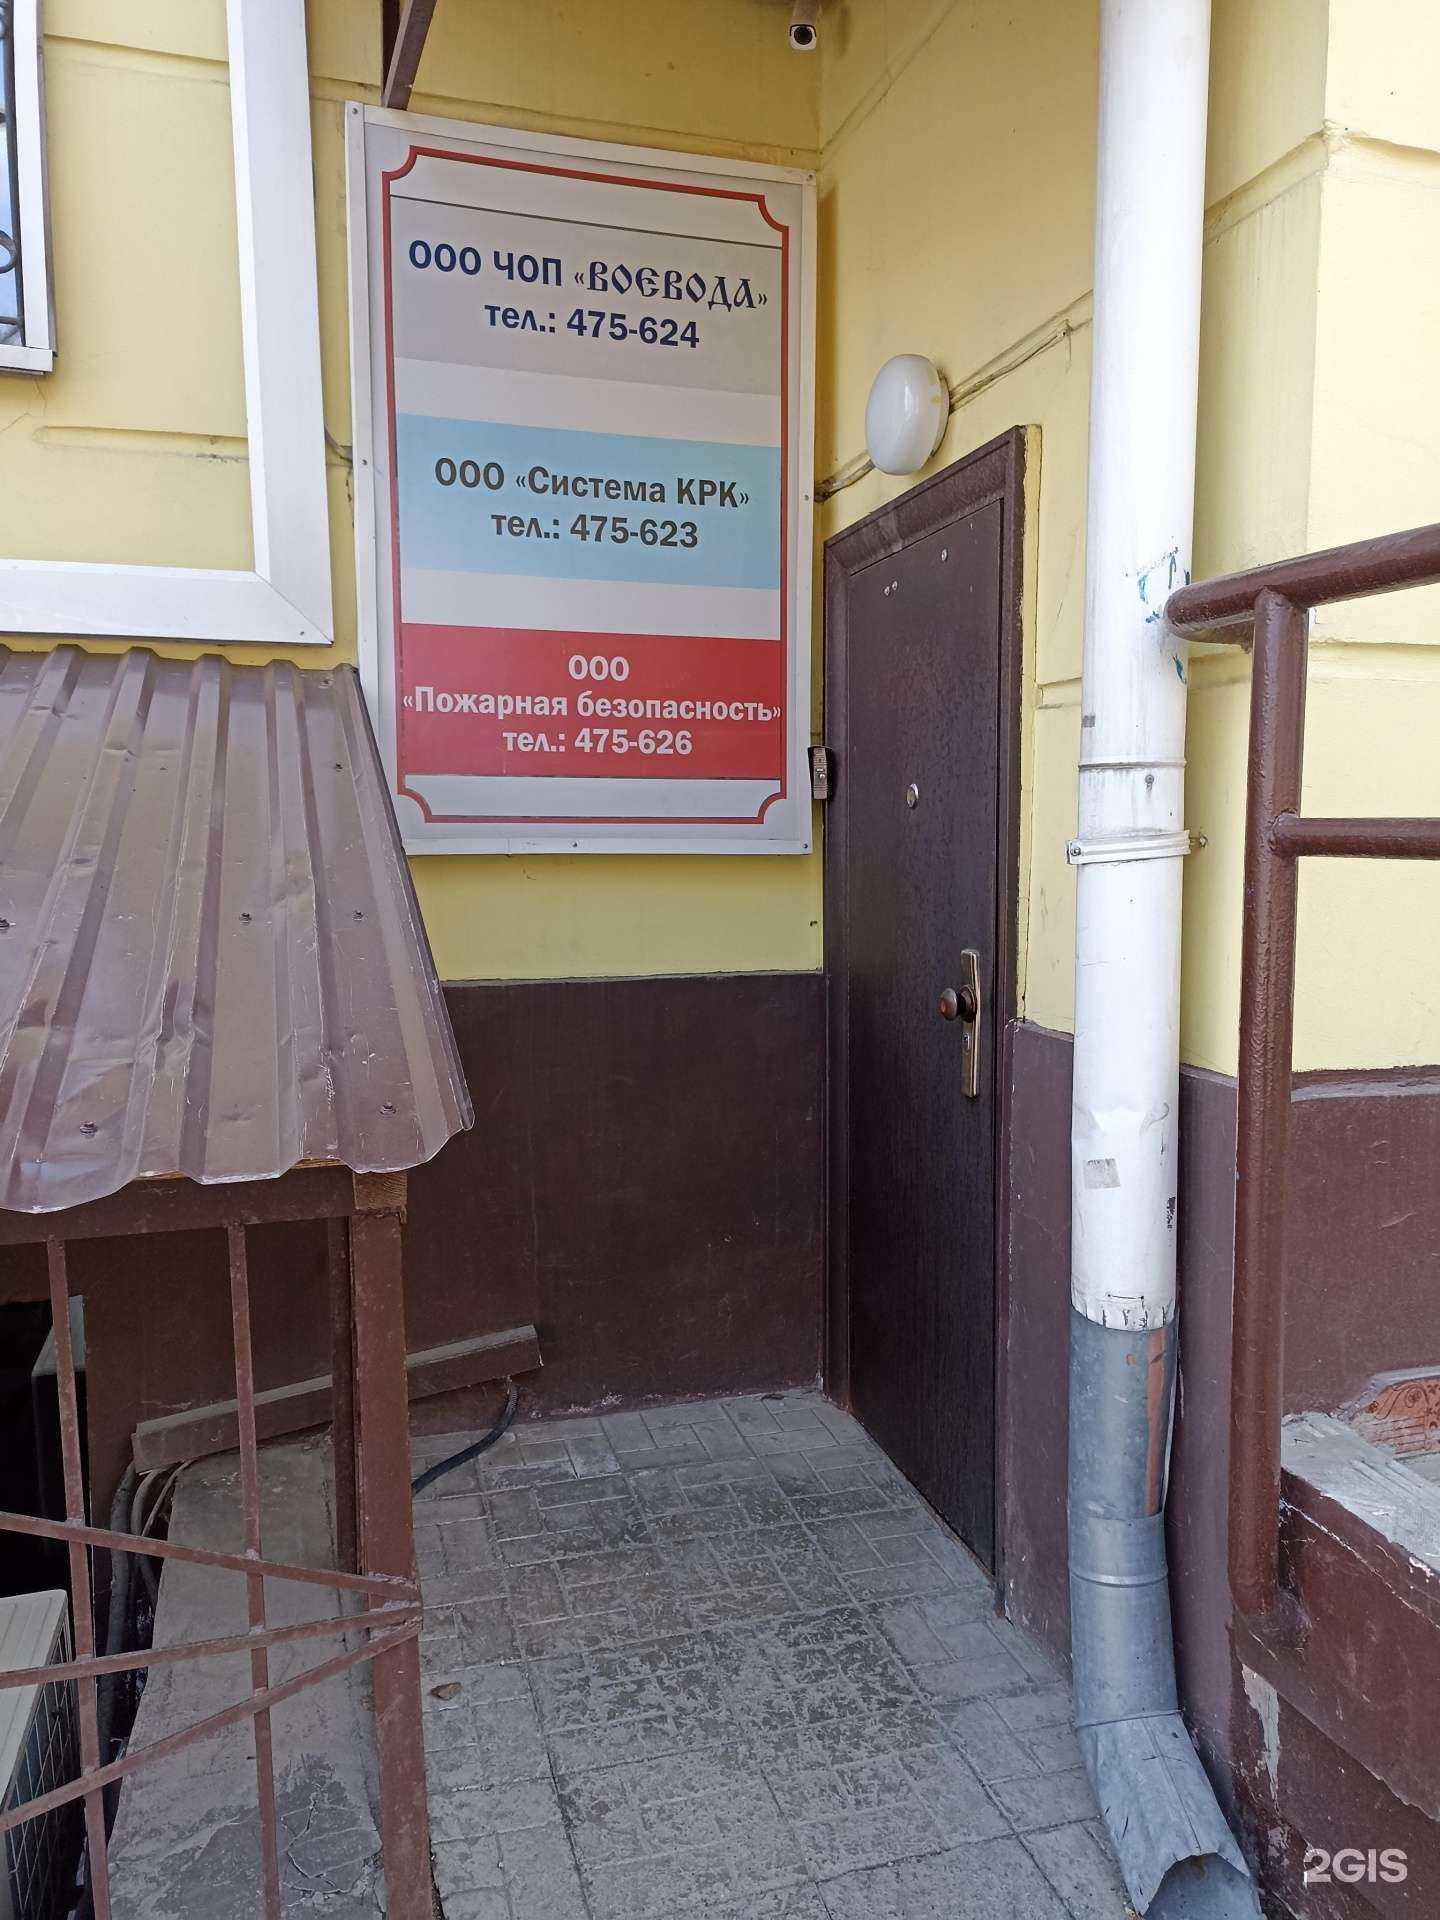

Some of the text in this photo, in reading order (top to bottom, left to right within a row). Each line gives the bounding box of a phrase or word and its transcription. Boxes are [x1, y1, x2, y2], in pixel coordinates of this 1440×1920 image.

[408, 240, 482, 275] ООО
[493, 250, 562, 286] ЧОП
[484, 304, 700, 349] тел.: 475-624
[435, 457, 749, 508] ООО «Система КРК»
[491, 513, 698, 548] тел.: 475-623
[568, 655, 630, 681] ООО
[403, 686, 781, 722] «Пожарная безопасность»
[502, 728, 693, 755] тел.: 475-626
